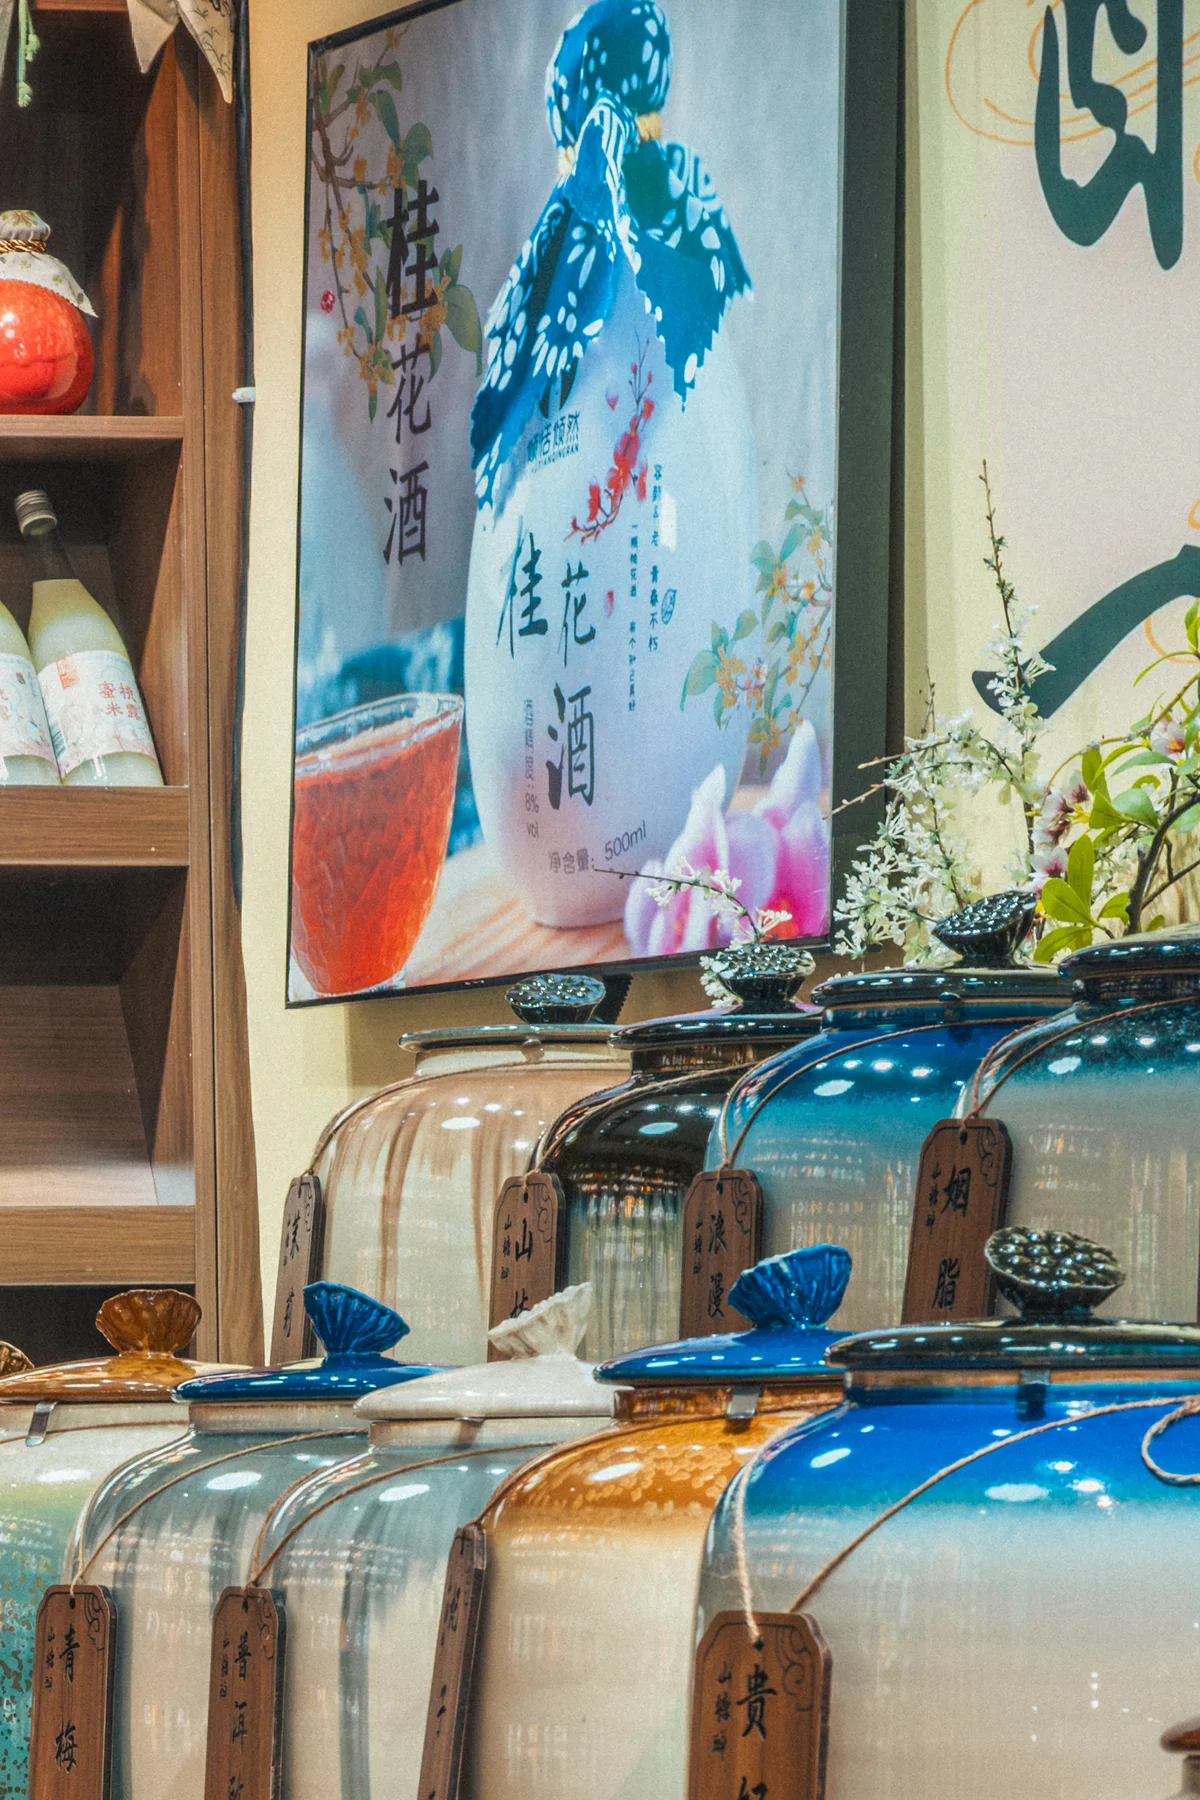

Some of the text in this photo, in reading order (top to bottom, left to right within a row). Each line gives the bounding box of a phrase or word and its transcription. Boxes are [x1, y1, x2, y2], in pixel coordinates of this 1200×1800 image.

[384, 186, 440, 567] 桂花酒
[496, 515, 596, 811] 桂花酒
[604, 819, 647, 862] 500ml
